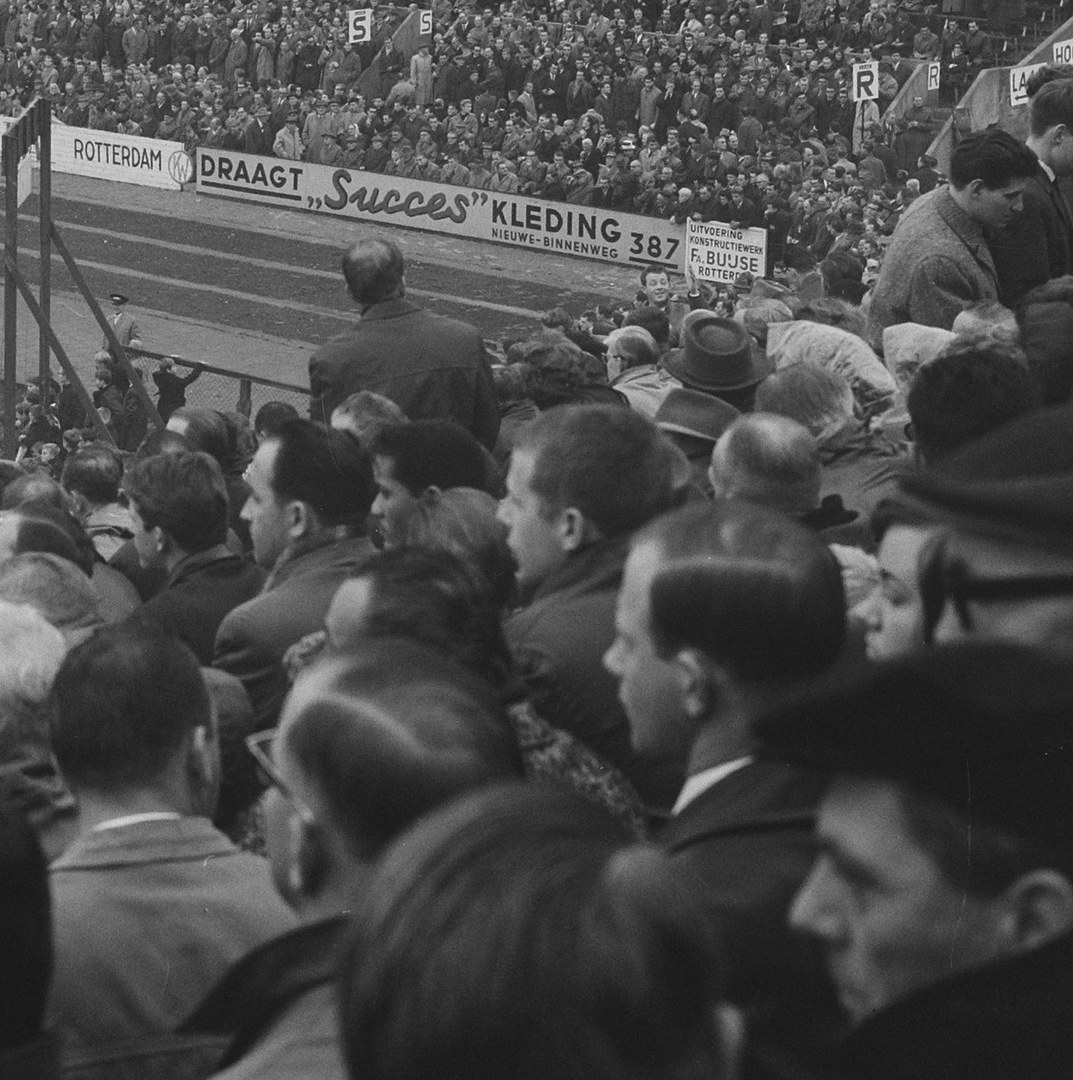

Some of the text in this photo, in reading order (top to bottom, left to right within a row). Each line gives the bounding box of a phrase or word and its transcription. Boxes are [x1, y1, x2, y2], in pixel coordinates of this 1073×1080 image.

[353, 16, 367, 41] S
[422, 12, 431, 33] S
[1056, 45, 1073, 64] HO
[857, 70, 874, 99] R
[930, 66, 939, 88] R
[74, 139, 163, 172] ROTTERDAM
[201, 153, 304, 191] DRAAGT
[492, 199, 622, 244] KLEDING
[629, 231, 680, 261] 387
[491, 227, 619, 259] NIEUWE-BINNENWEG
[690, 223, 743, 241] UITVOERING
[689, 235, 765, 256] KONSTRUCTIEWERK
[698, 265, 741, 281] ROTTERD
